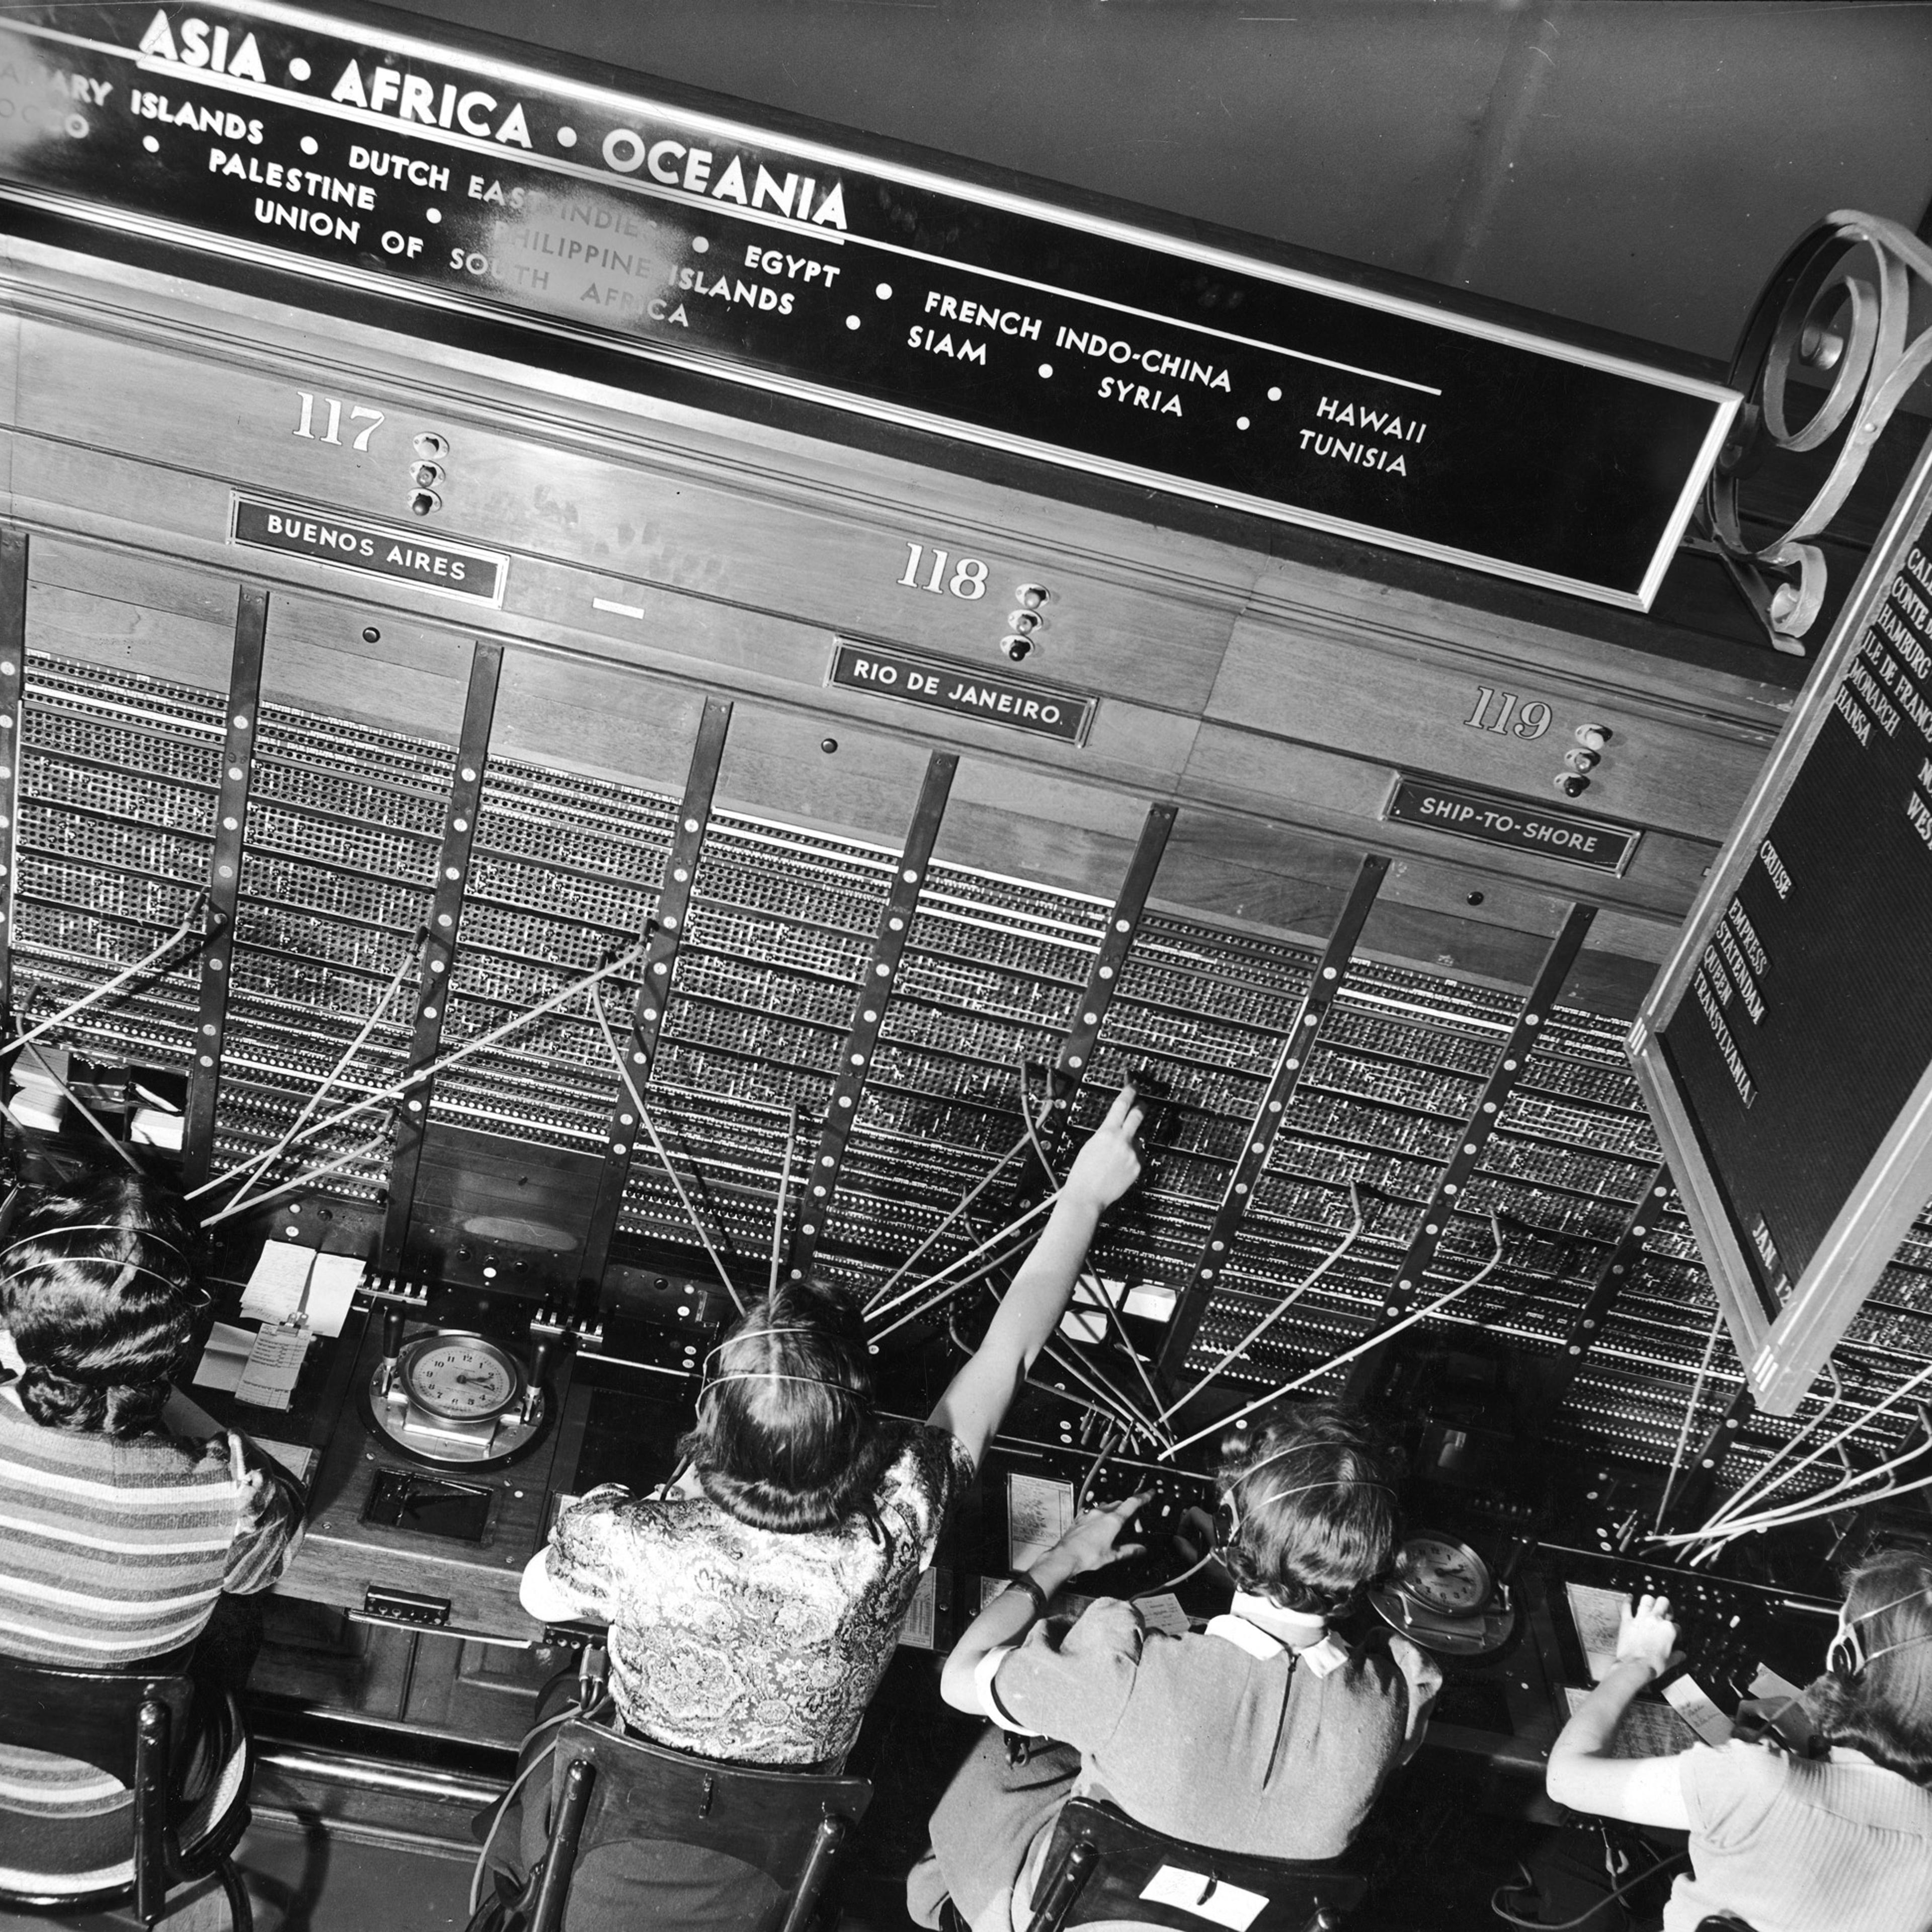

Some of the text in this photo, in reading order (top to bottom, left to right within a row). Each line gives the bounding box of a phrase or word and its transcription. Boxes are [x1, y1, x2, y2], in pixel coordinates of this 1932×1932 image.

[139, 9, 847, 229] ASIA AFRICA OCEANIA
[131, 89, 264, 145] ISLANDS
[349, 145, 450, 191] DUTCH
[468, 175, 548, 211] EAST
[745, 246, 840, 288] EGYPT
[925, 291, 1042, 341] FRENCH
[1056, 326, 1232, 393] INDO-CHINA
[1316, 396, 1426, 443] HAWAII
[255, 197, 689, 328] UNION OF SOUTH AFRICA
[209, 148, 377, 211] PALESTINE
[495, 220, 651, 279] PHILIPPINE
[668, 264, 795, 315] ISLANDS
[907, 325, 987, 366] SIAM
[1097, 376, 1183, 417] SYRIA
[1299, 429, 1407, 476] TUNISIA
[292, 391, 385, 452] 117
[267, 514, 465, 581] BUENOS AIRES
[897, 542, 989, 600] 118
[1892, 576, 1929, 630] CONTE
[1863, 629, 1883, 665] ILE
[1879, 654, 1898, 686] DE
[1877, 604, 1932, 679] HAMBURG
[853, 659, 1060, 724] RIO DE JANEIRO
[1464, 685, 1553, 740] 119
[1835, 684, 1871, 746] HANSA
[1847, 657, 1900, 737] MONARCH
[1420, 796, 1597, 853] SHIP-TO-SHORE
[1760, 840, 1792, 900] CRUISE
[1728, 898, 1768, 976] EMPRESS
[1704, 944, 1733, 1007] QUEEN
[1716, 920, 1765, 1025] STATENDAM
[1693, 968, 1751, 1103] TRANSYLVANIA
[1752, 1219, 1777, 1270] JAN.
